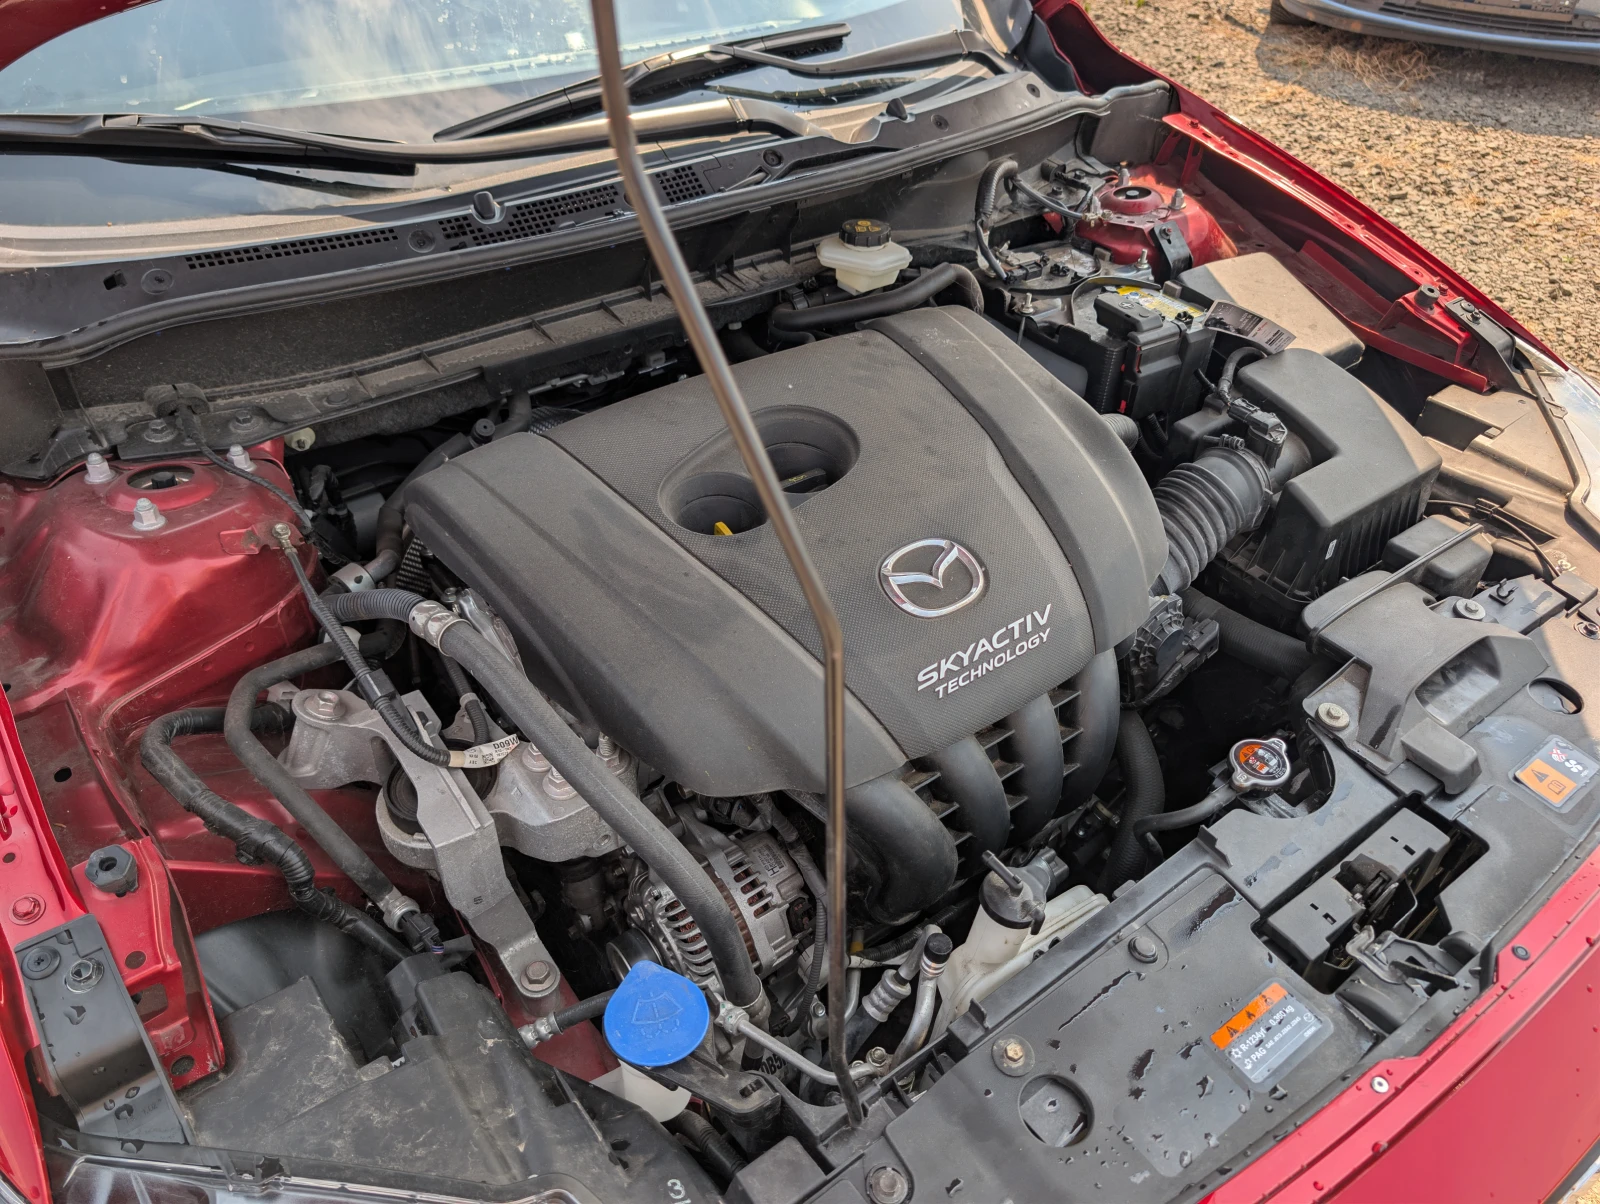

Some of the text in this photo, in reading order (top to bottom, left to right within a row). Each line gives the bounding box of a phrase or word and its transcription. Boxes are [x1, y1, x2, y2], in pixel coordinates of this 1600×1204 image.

[917, 603, 1052, 692] SKYACTIV
[934, 627, 1051, 699] TECHNOLOGY
[1239, 1026, 1268, 1053] R-1234yf
[1284, 1004, 1295, 1015] kg
[1250, 1047, 1267, 1063] PAG
